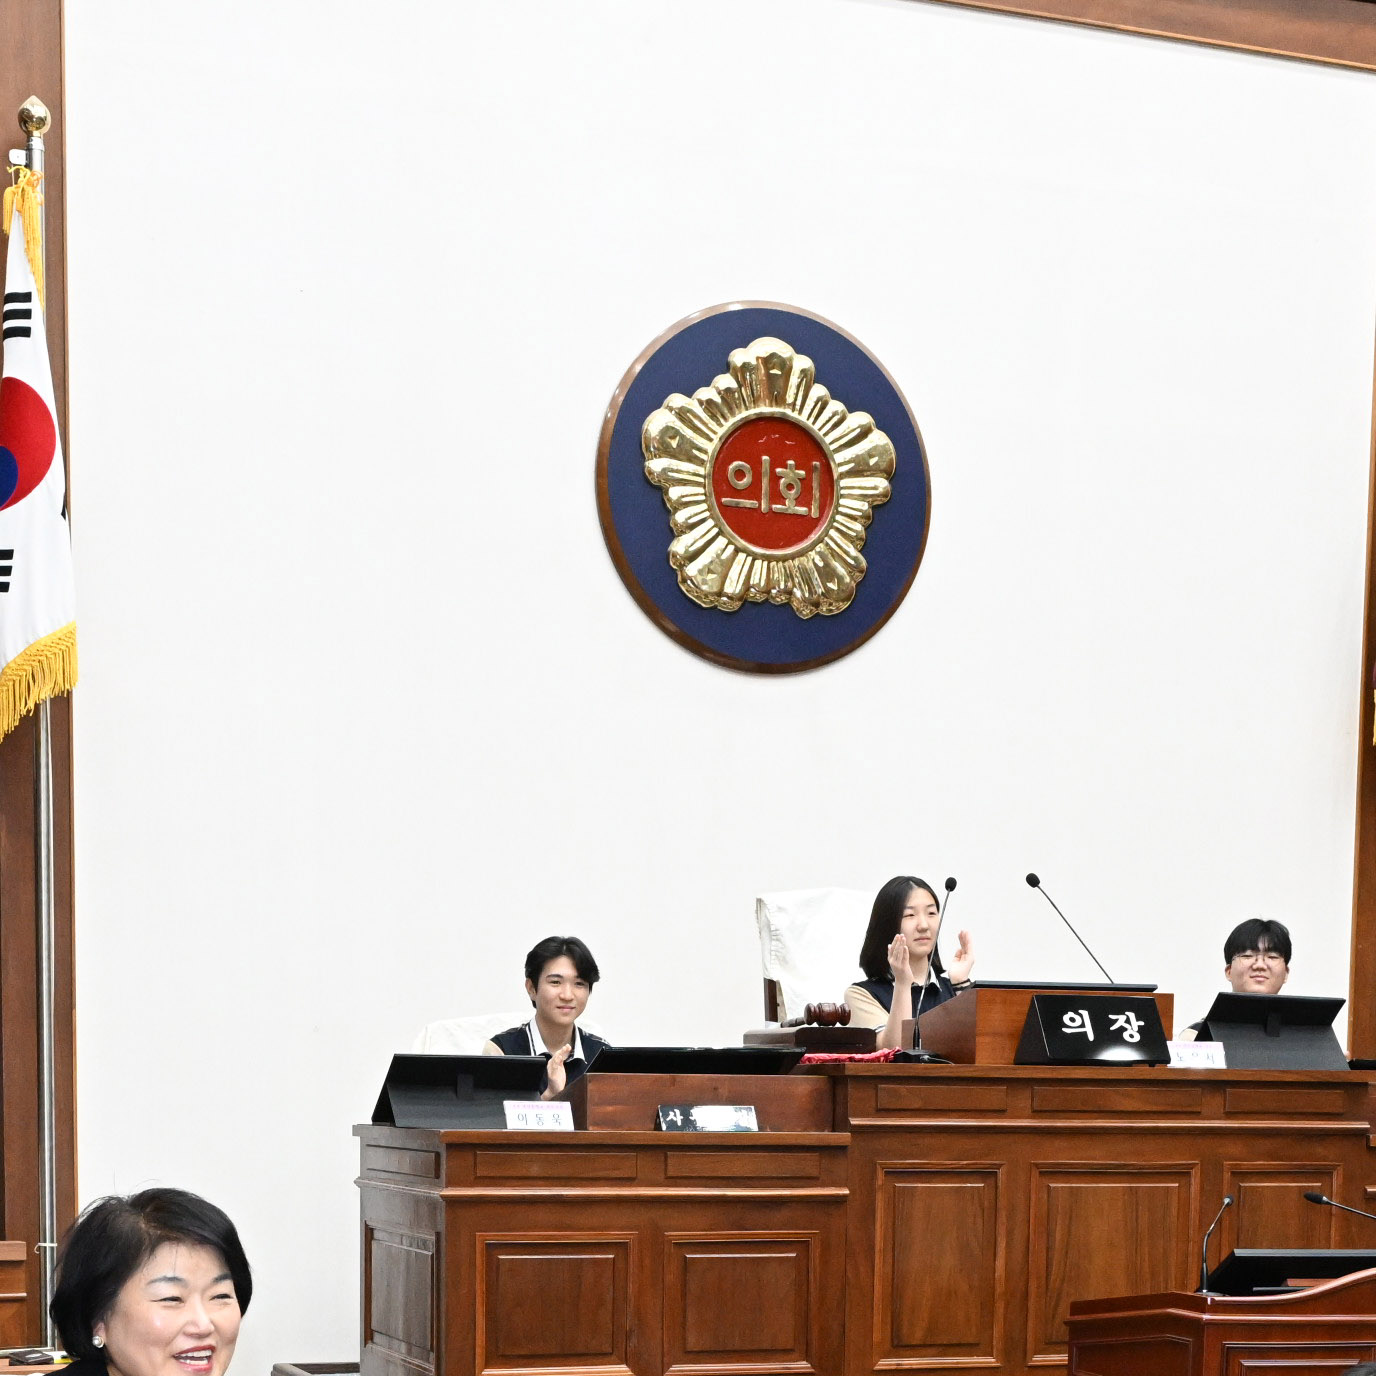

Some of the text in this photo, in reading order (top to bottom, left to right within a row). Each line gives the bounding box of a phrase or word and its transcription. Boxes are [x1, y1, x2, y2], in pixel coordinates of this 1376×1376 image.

[720, 455, 822, 519] 의회
[1061, 1009, 1145, 1043] 의장
[517, 1112, 562, 1127] 이동욱
